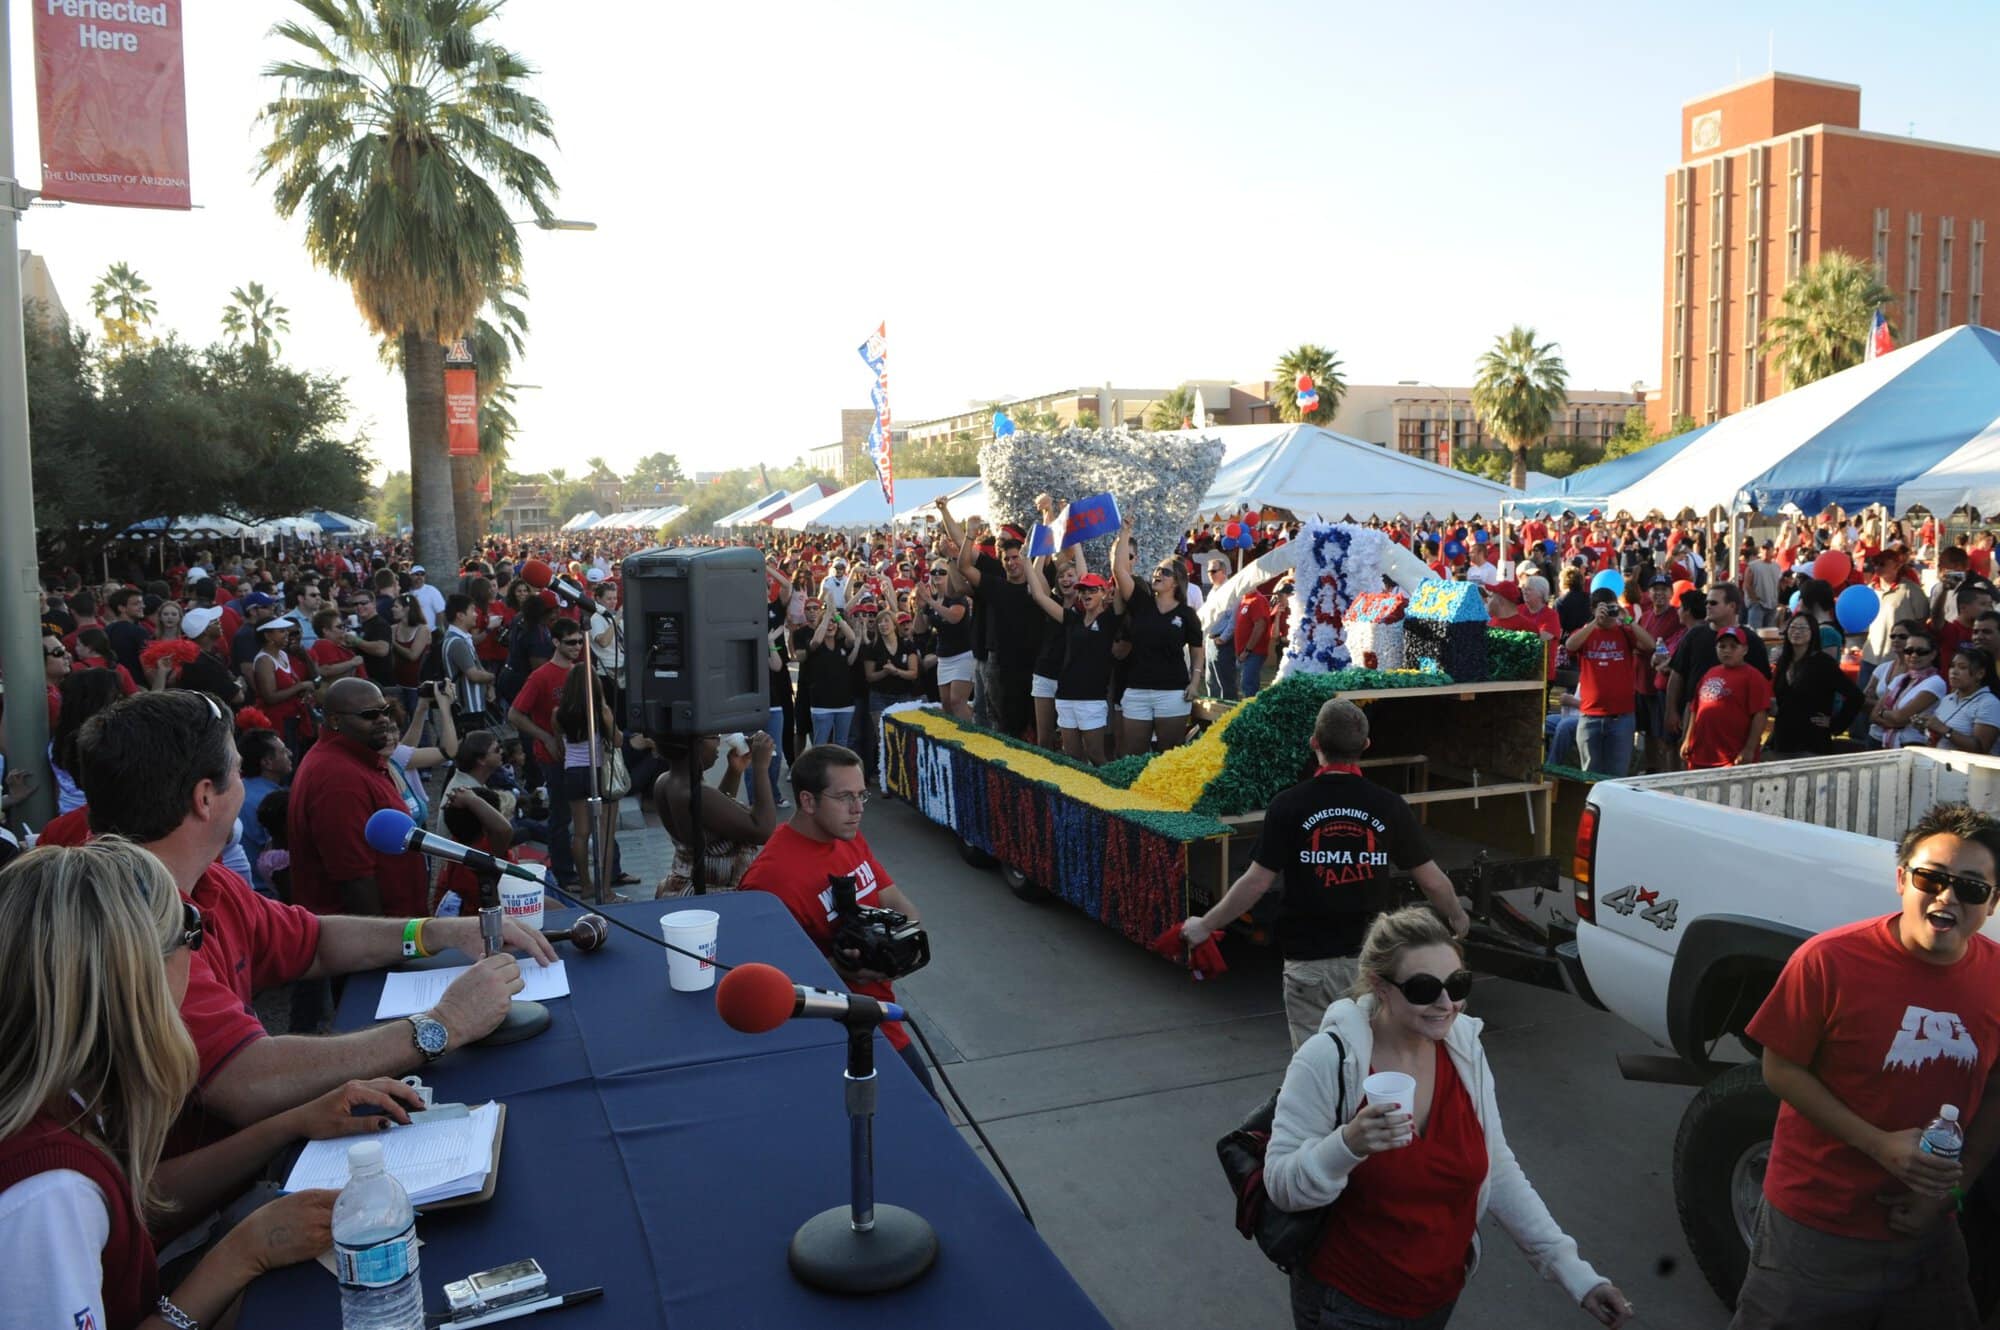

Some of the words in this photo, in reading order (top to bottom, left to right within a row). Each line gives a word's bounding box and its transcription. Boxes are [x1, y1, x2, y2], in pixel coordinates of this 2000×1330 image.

[47, 0, 168, 26] Perfected
[78, 23, 139, 52] Here
[44, 170, 64, 181] THE
[65, 170, 122, 184] UNIVERSITY
[123, 174, 139, 184] OF
[140, 175, 186, 188] ARIZONA
[1302, 807, 1369, 831] HOMECOMING
[1300, 850, 1353, 864] SIGMA
[1359, 851, 1388, 865] CHI
[504, 902, 542, 915] REMEMBER
[507, 899, 521, 907] YOU
[524, 896, 538, 906] CAN
